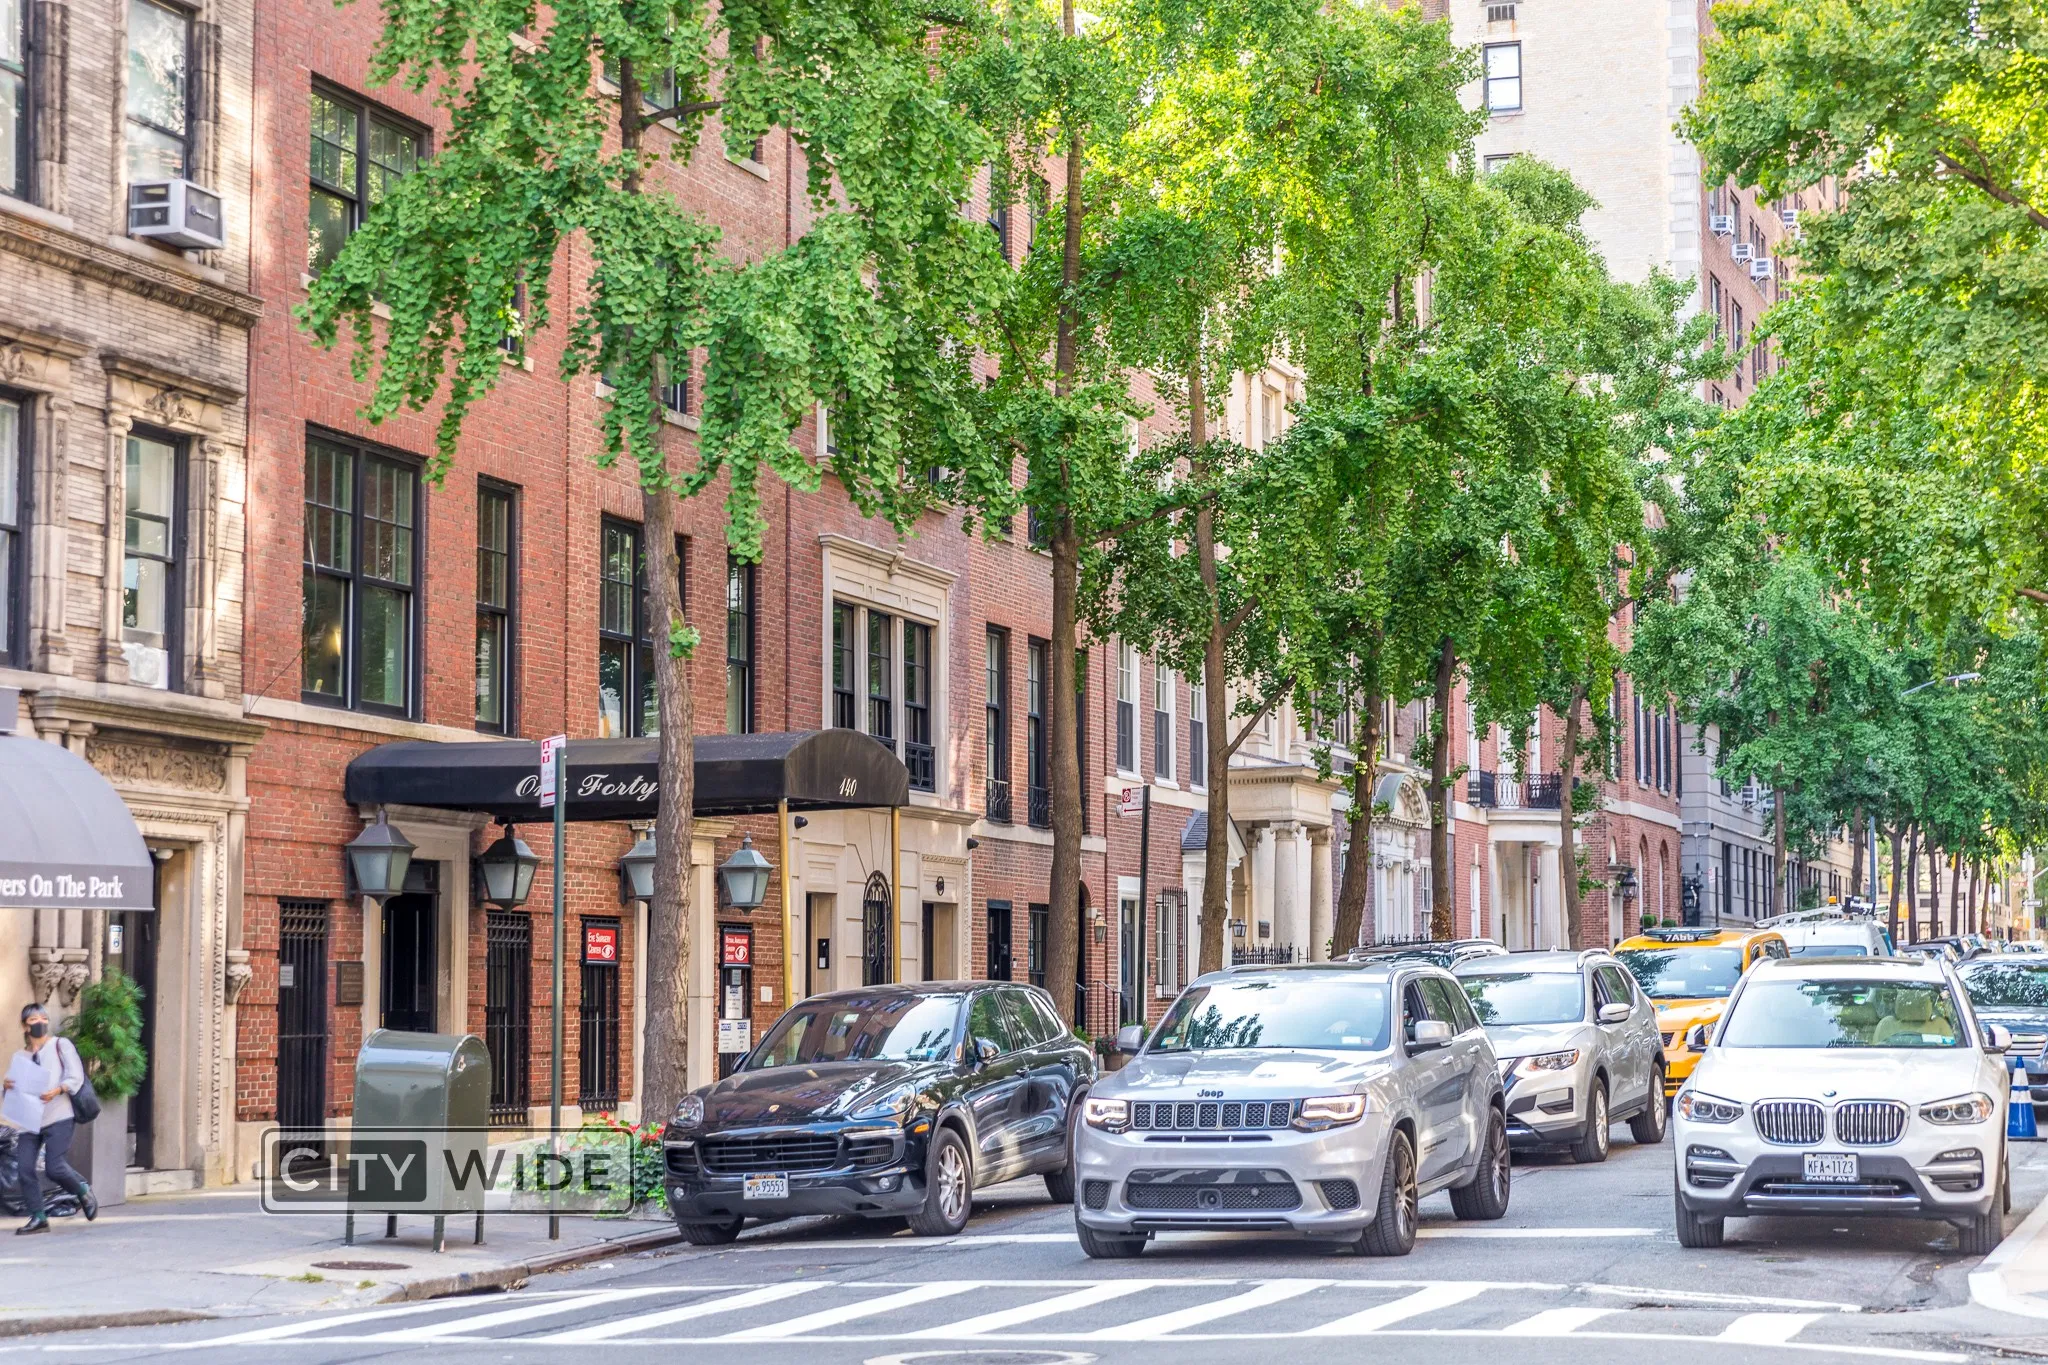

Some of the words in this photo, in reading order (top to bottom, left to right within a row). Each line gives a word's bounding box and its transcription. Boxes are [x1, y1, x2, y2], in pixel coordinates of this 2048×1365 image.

[578, 774, 658, 802] Forty
[839, 777, 857, 797] 140
[29, 874, 53, 897] On
[56, 874, 86, 898] The
[89, 875, 123, 898] Park
[1197, 1089, 1224, 1099] Jeep
[762, 1180, 784, 1192] 95553
